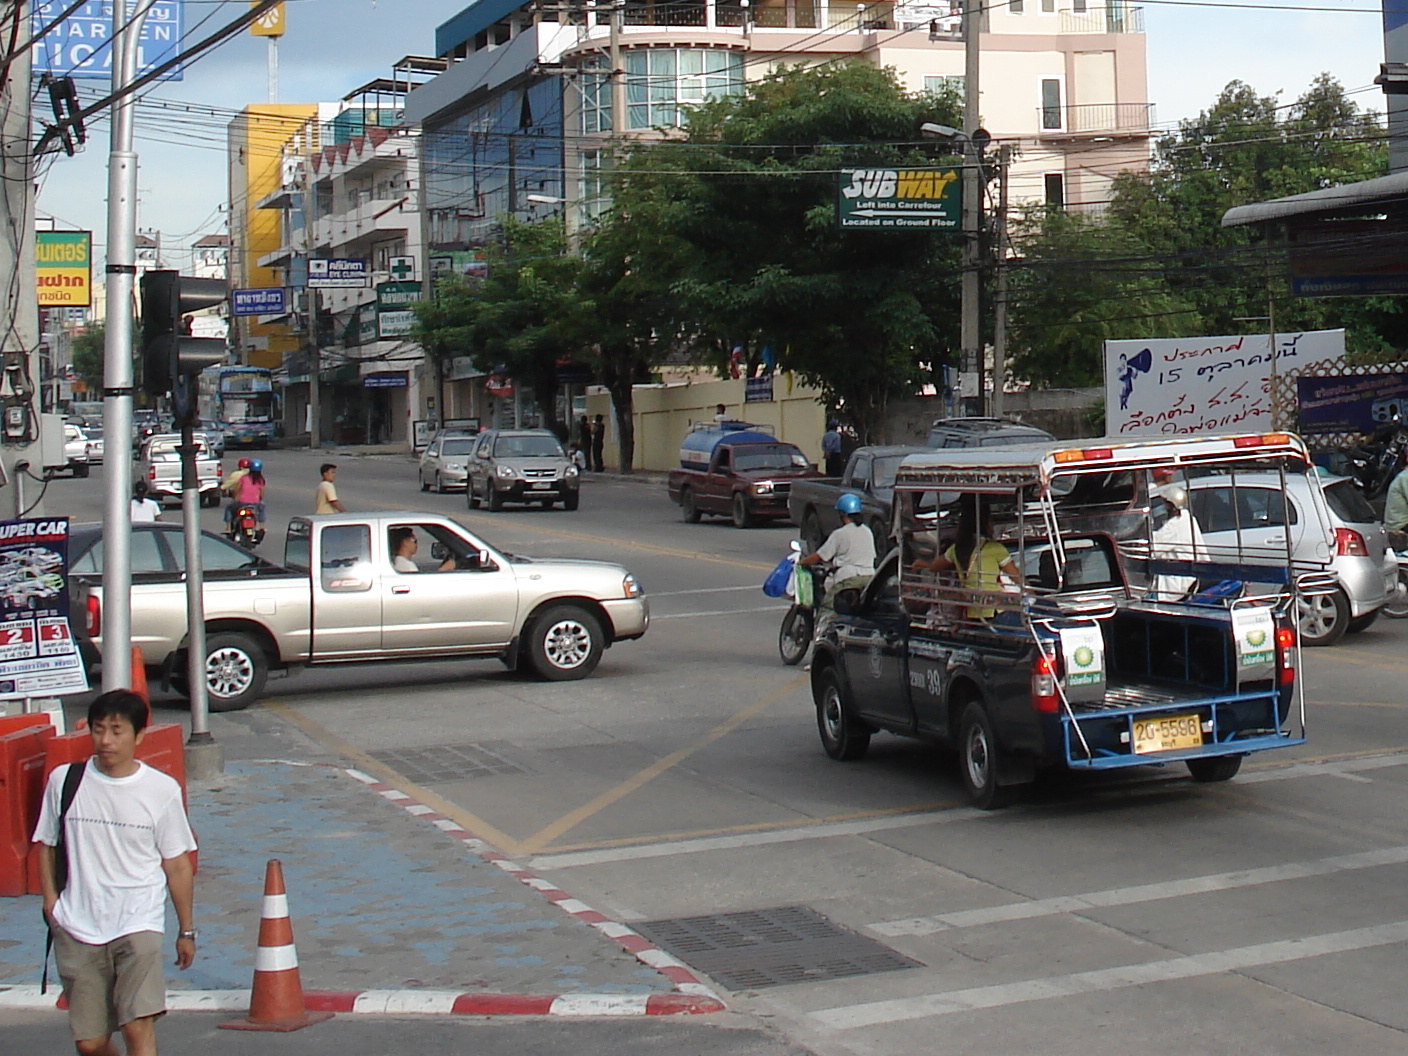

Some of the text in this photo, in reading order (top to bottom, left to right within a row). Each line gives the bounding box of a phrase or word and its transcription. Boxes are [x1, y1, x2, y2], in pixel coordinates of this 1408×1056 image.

[841, 169, 958, 199] SUBWAY
[898, 201, 942, 209] Carrefour
[842, 218, 880, 226] Located
[1164, 337, 1244, 362] ประกาศ
[1159, 368, 1182, 385] 15
[36, 521, 68, 535] CAR
[7, 630, 24, 644] 2
[51, 625, 62, 639] 3
[927, 669, 941, 696] 39
